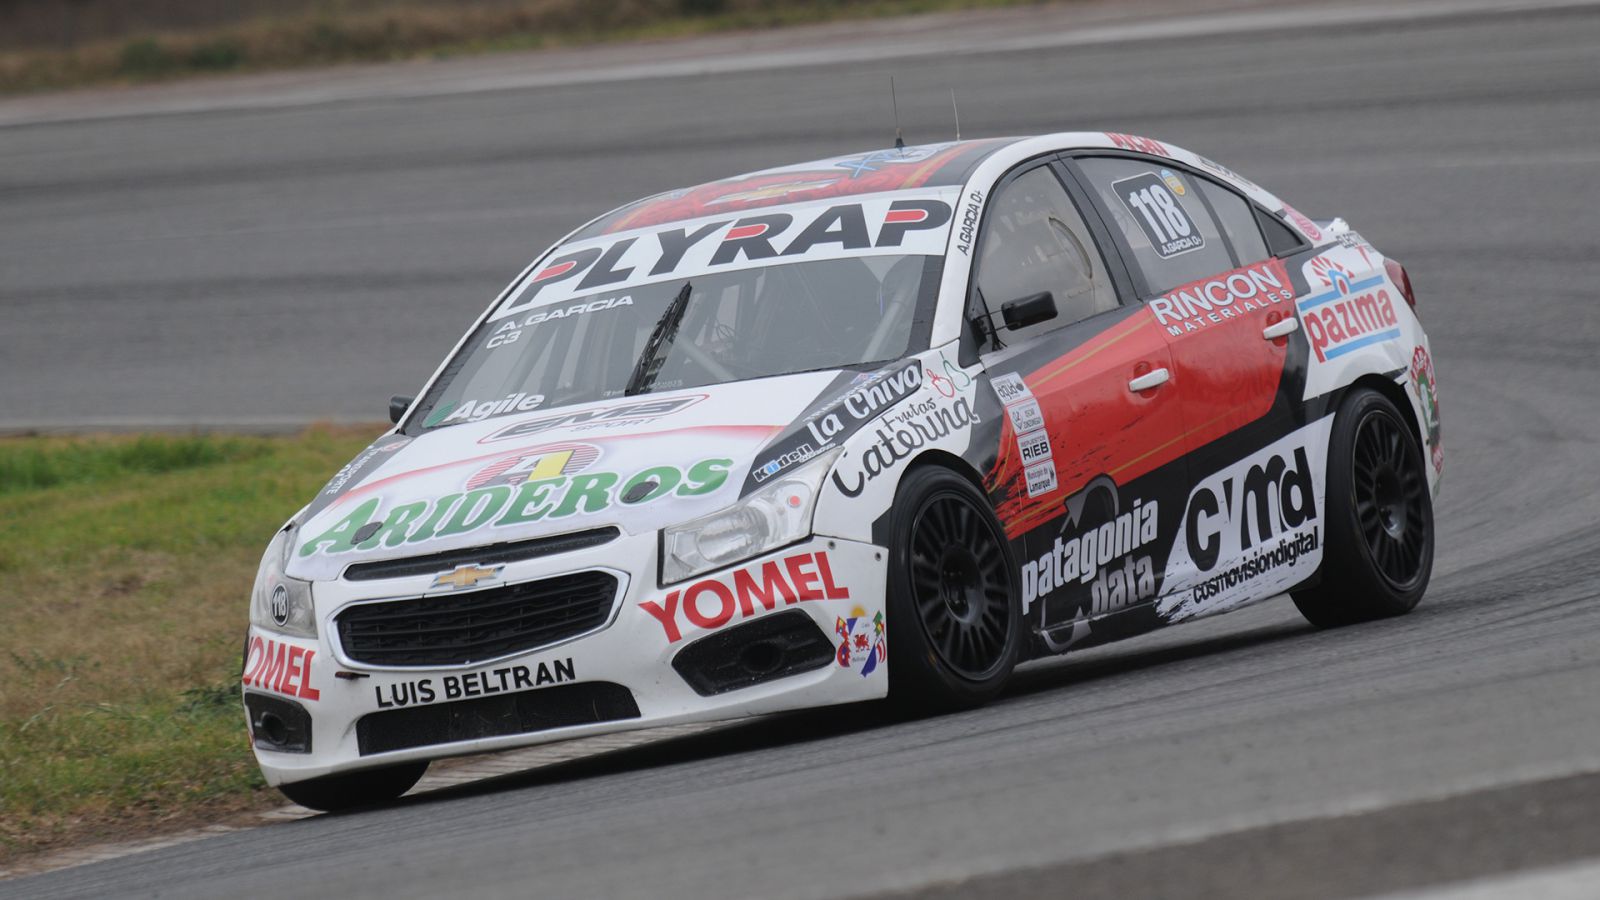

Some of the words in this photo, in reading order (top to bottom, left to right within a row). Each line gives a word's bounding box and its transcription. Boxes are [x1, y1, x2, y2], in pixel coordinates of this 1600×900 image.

[1128, 184, 1191, 244] 118
[504, 200, 954, 313] PLYRAP
[1149, 265, 1281, 326] RINCON
[1167, 288, 1294, 338] MATERIALES
[1303, 287, 1398, 363] pazima
[486, 329, 522, 349] C3
[444, 392, 545, 421] Agile
[844, 364, 921, 419] Chiva
[831, 396, 981, 498] Caterina
[1022, 441, 1049, 460] RIEB
[299, 458, 734, 558] ARIDEROS
[1021, 498, 1158, 615] patagonia
[1091, 554, 1155, 615] data
[271, 590, 288, 618] 118
[638, 551, 850, 644] YOMEL
[242, 636, 320, 701] OMEL
[375, 679, 436, 708] LUIS
[443, 657, 576, 699] BELTRAN
